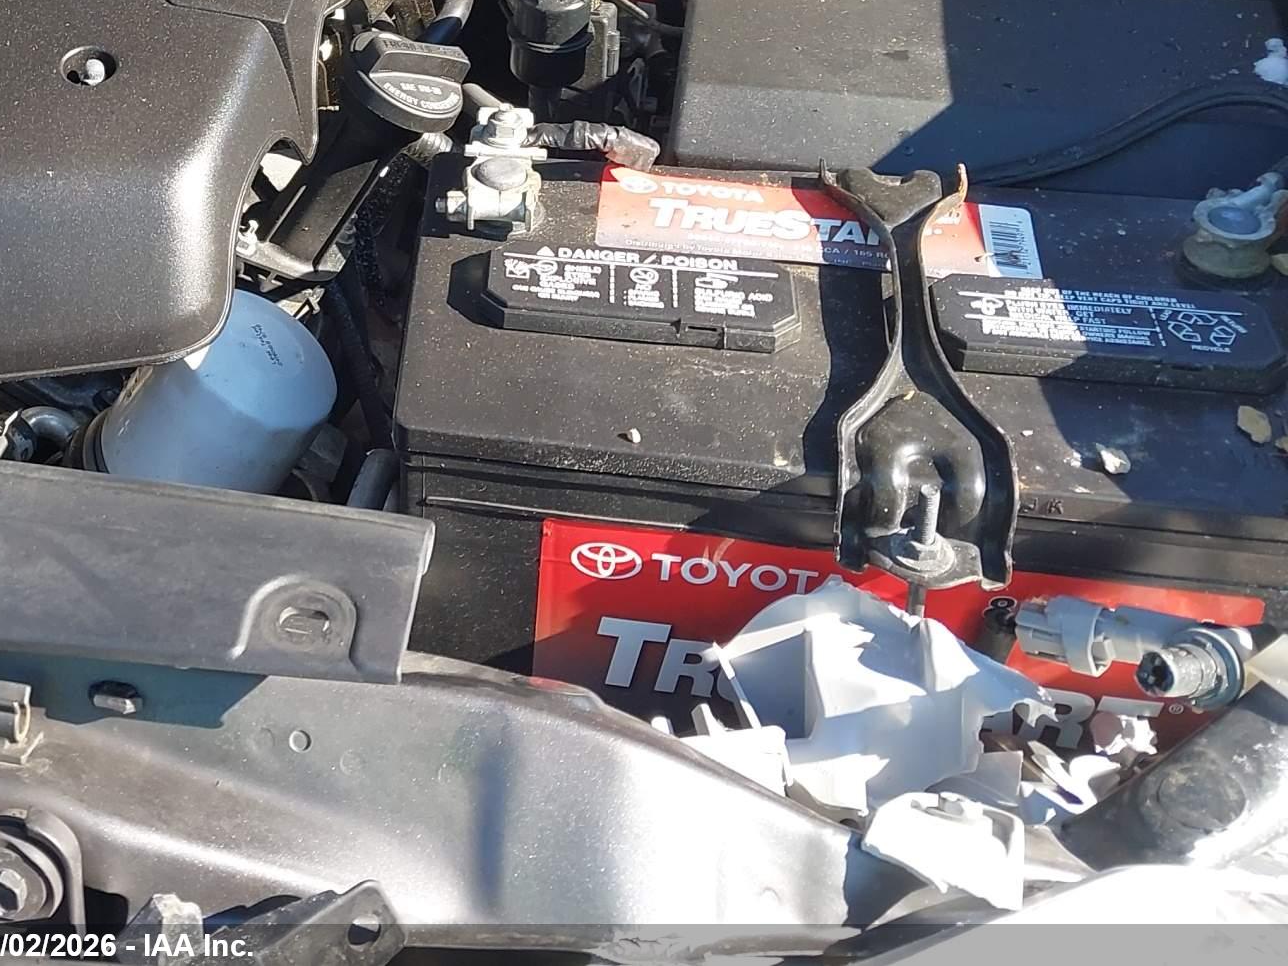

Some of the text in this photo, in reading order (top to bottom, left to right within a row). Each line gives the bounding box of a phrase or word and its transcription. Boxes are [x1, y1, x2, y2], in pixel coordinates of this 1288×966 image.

[661, 181, 765, 203] TOYOTA
[558, 247, 640, 264] DANGER
[661, 254, 738, 271] POISON
[1066, 304, 1132, 315] IMMEDIATELY
[1075, 310, 1094, 318] GET
[1191, 344, 1231, 353] RECYCLE
